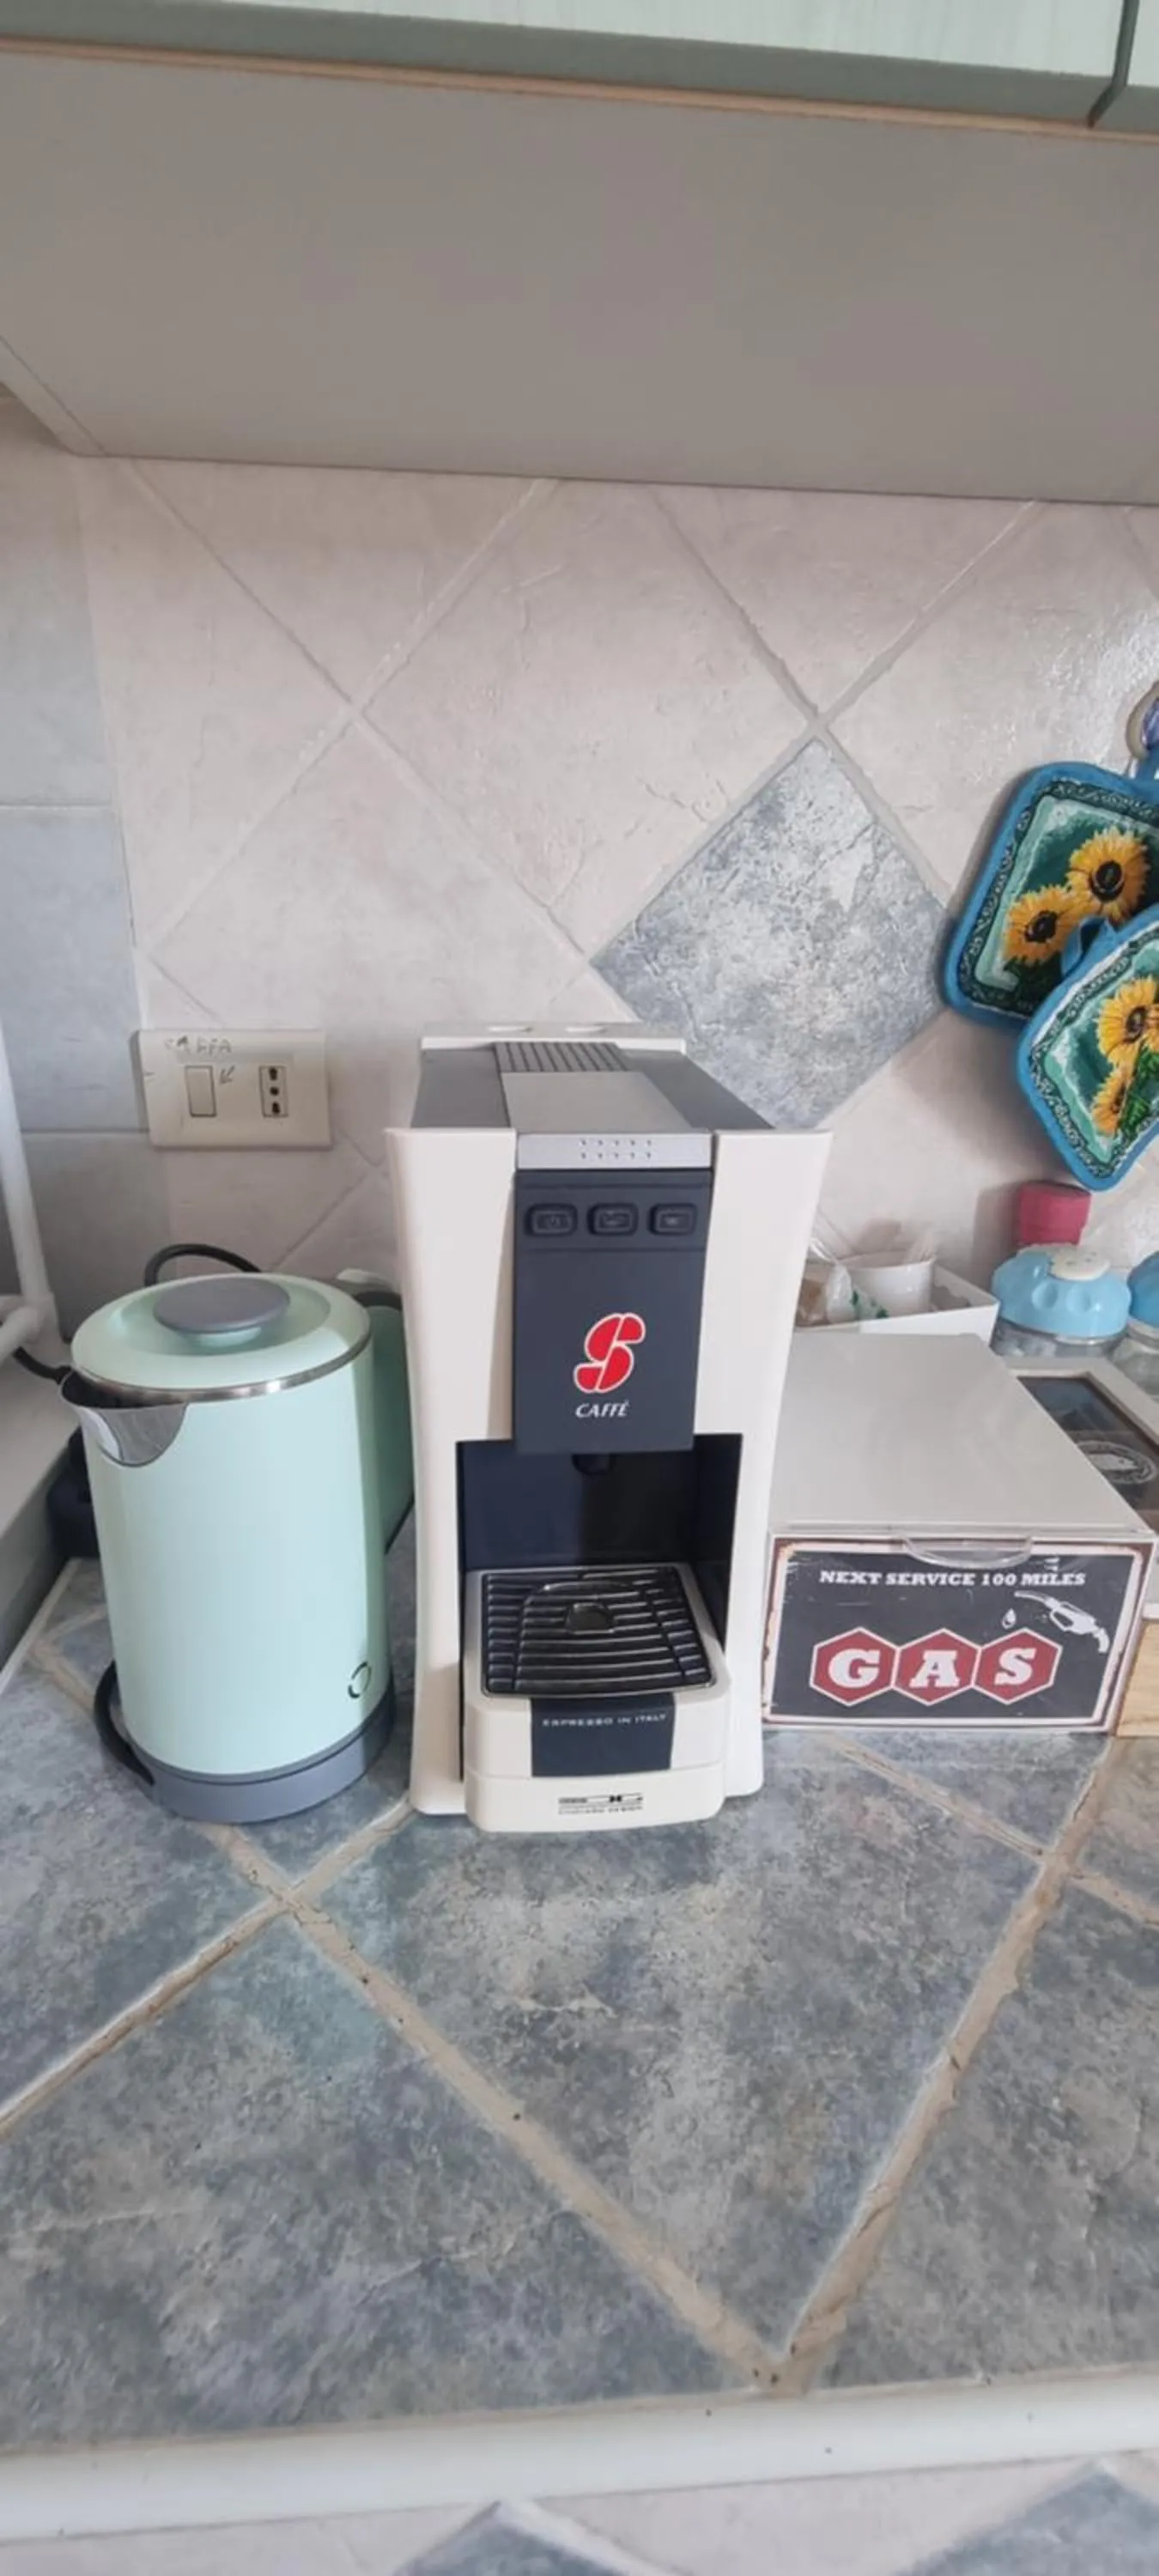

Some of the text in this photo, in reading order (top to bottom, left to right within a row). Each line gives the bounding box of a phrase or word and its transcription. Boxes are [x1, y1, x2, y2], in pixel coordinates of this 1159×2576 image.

[819, 1571, 1086, 1587] NEXT SERVICE 100 MILES
[828, 1647, 1036, 1689] GAS
[617, 1716, 632, 1725] IN
[634, 1713, 667, 1723] ITALY
